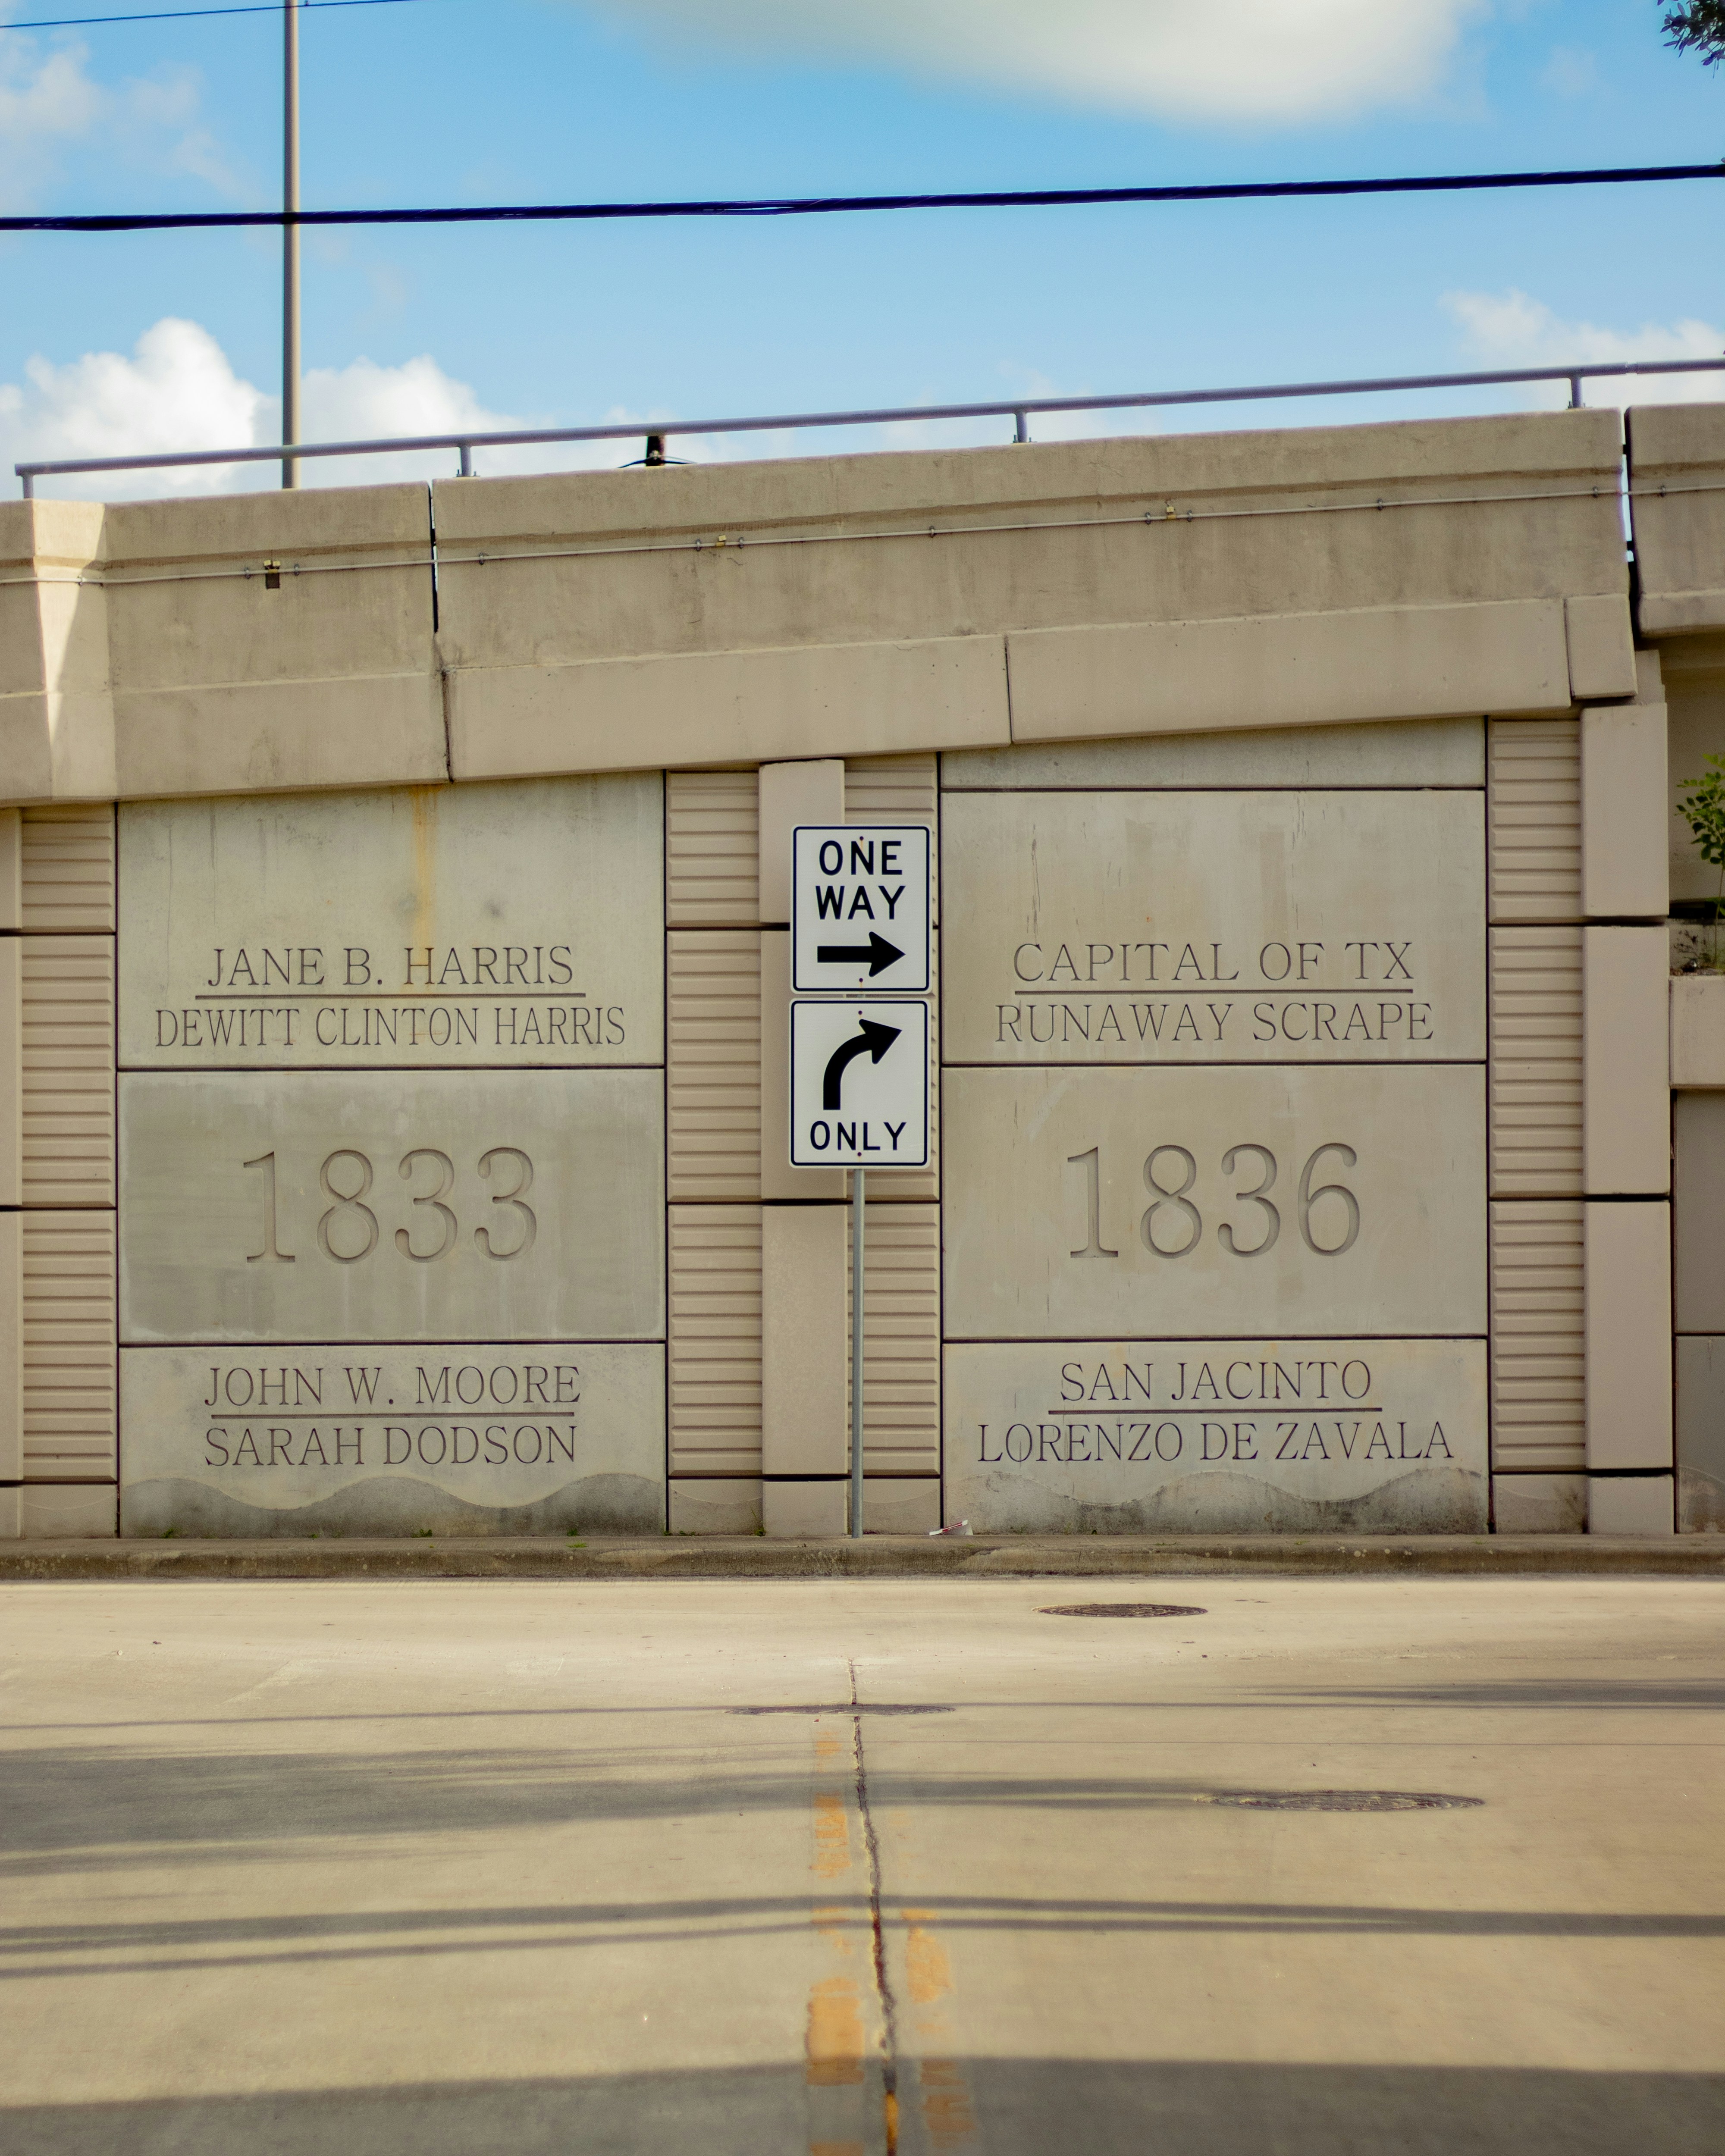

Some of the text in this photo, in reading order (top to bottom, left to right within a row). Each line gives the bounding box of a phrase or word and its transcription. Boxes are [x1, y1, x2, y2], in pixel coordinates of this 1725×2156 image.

[819, 840, 903, 875] ONE
[815, 886, 906, 920] WAY
[208, 946, 573, 987] JANE B. HARRIS
[1013, 943, 1414, 982] CAPITAL OF TX
[155, 1007, 625, 1047] DEWITT CLINTON HARRIS
[995, 1003, 1434, 1042] RUNAWAY SCRAPE
[810, 1121, 906, 1150] ONLY
[243, 1147, 537, 1264] 1833
[1067, 1143, 1360, 1259] 1836
[204, 1366, 581, 1407] JOHN W. MOORE
[1060, 1360, 1371, 1402] SAN JACINTO
[205, 1426, 577, 1467] SARAH DODSON
[977, 1421, 1455, 1463] LORENZO DE ZAVALA
